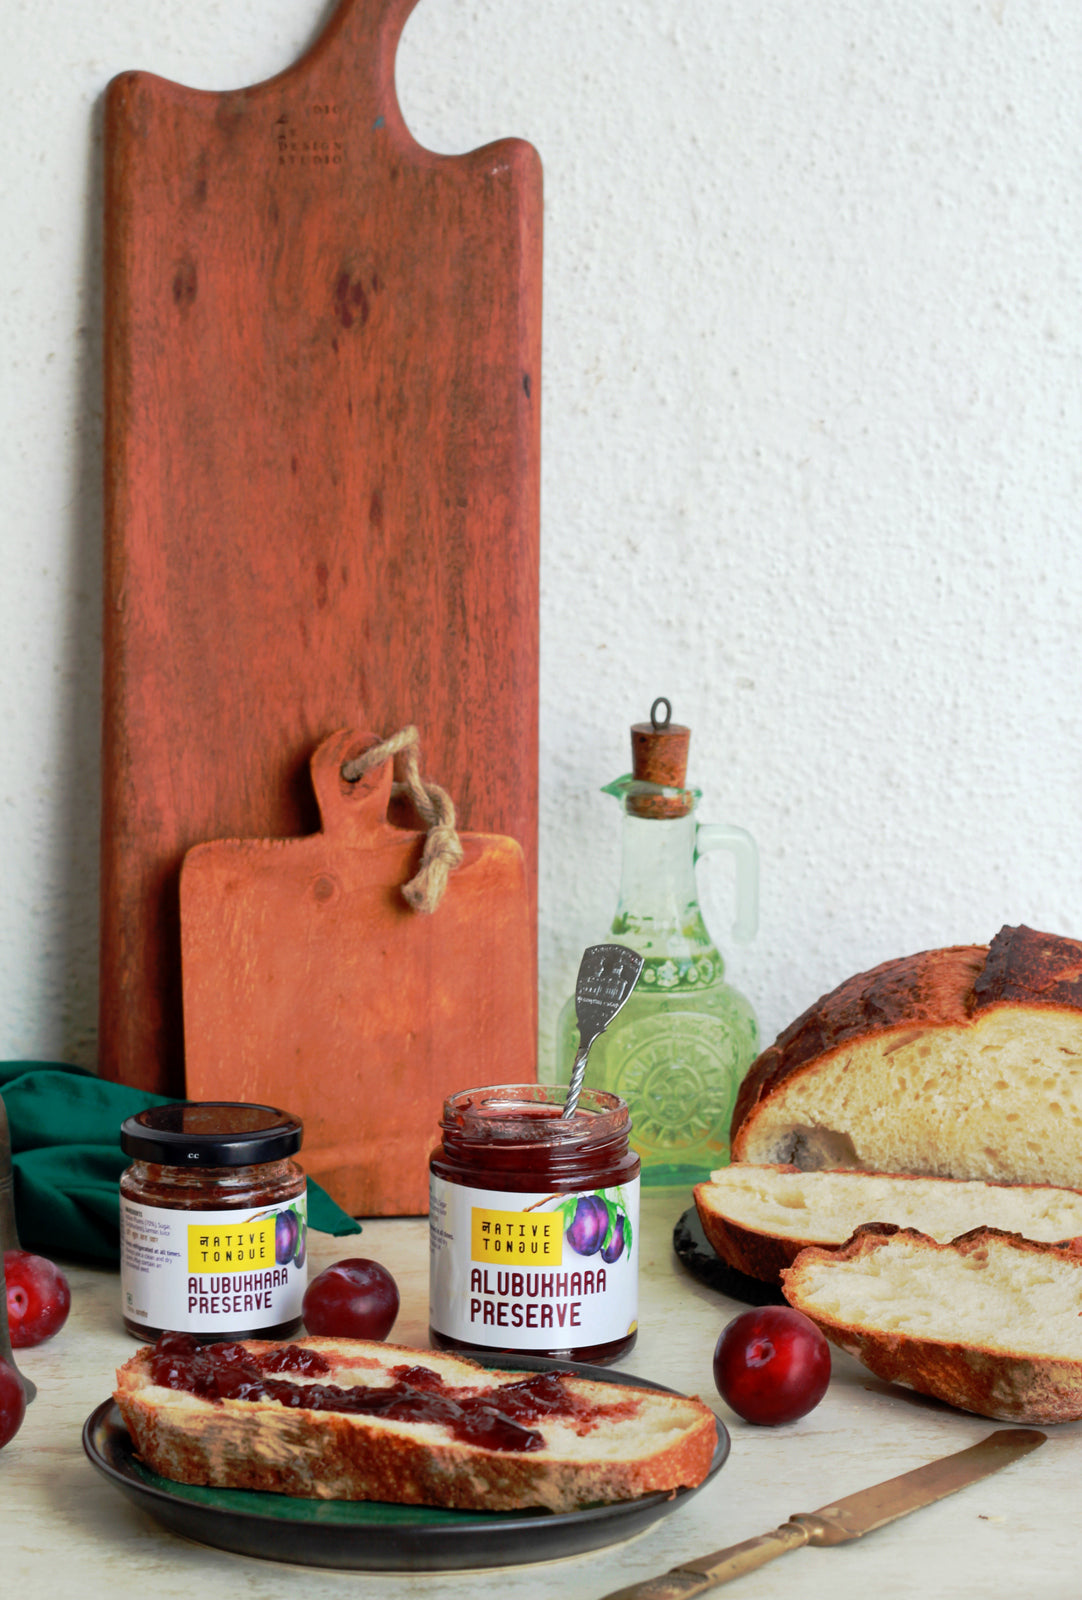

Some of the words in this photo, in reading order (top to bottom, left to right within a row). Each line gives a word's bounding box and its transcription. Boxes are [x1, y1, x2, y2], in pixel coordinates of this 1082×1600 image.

[188, 1267, 288, 1294] ALUBUKHARA
[471, 1268, 606, 1298] ALUBUKHARA
[188, 1291, 272, 1314] PRESERVE
[471, 1298, 582, 1328] PRESERVE
